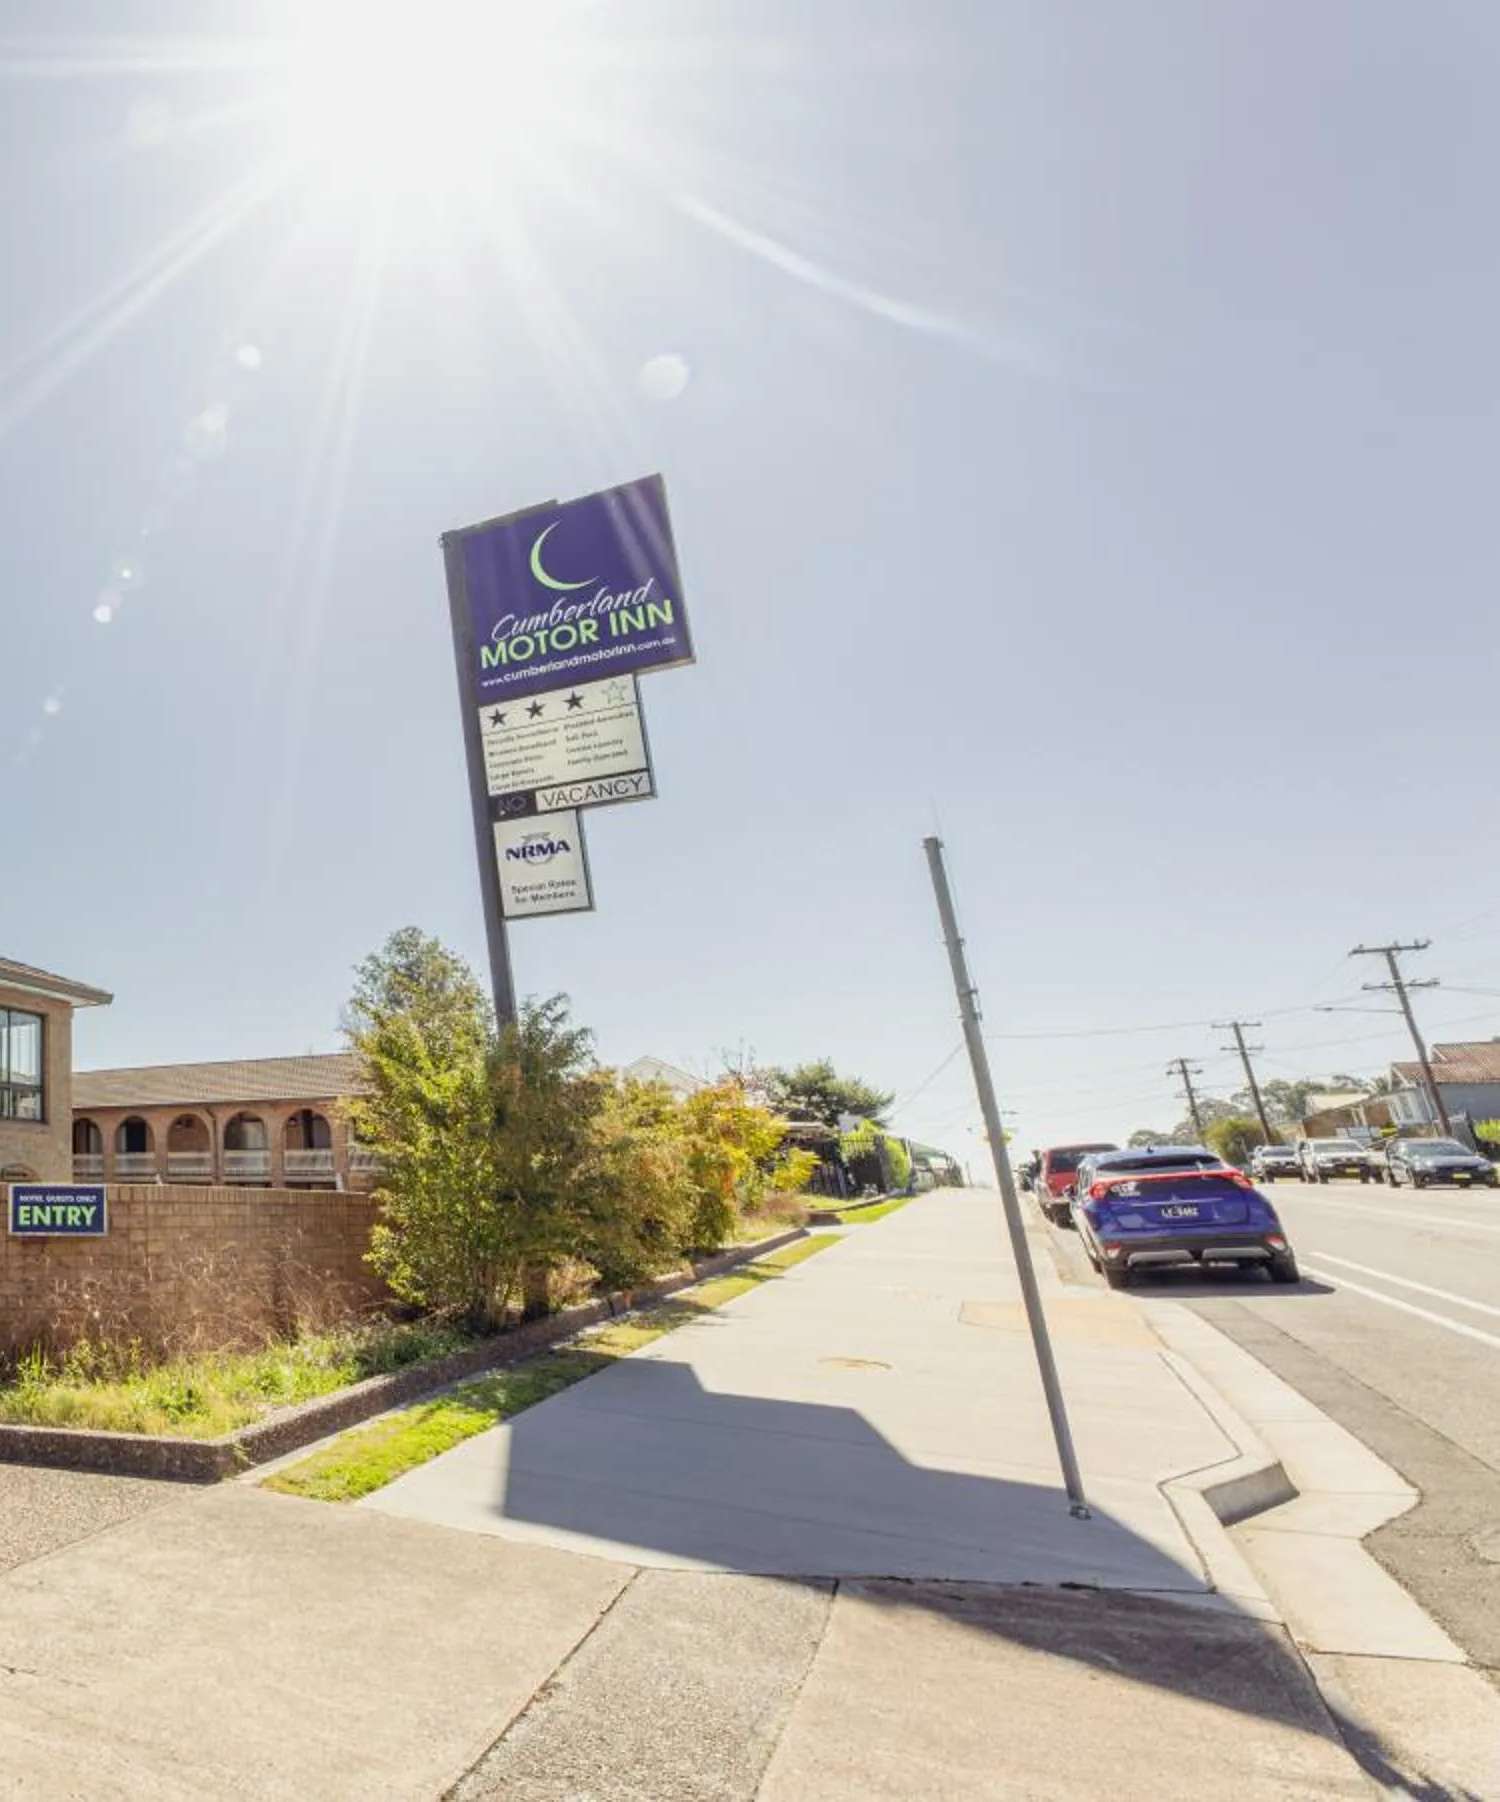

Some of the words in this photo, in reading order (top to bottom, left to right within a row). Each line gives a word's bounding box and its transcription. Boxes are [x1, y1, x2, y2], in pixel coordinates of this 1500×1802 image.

[491, 577, 655, 642] Cumberland
[481, 619, 598, 668] MOTOR
[610, 600, 674, 636] INN
[541, 776, 644, 807] VACANCY
[505, 839, 571, 861] NRMA
[18, 1205, 97, 1226] ENTRY
